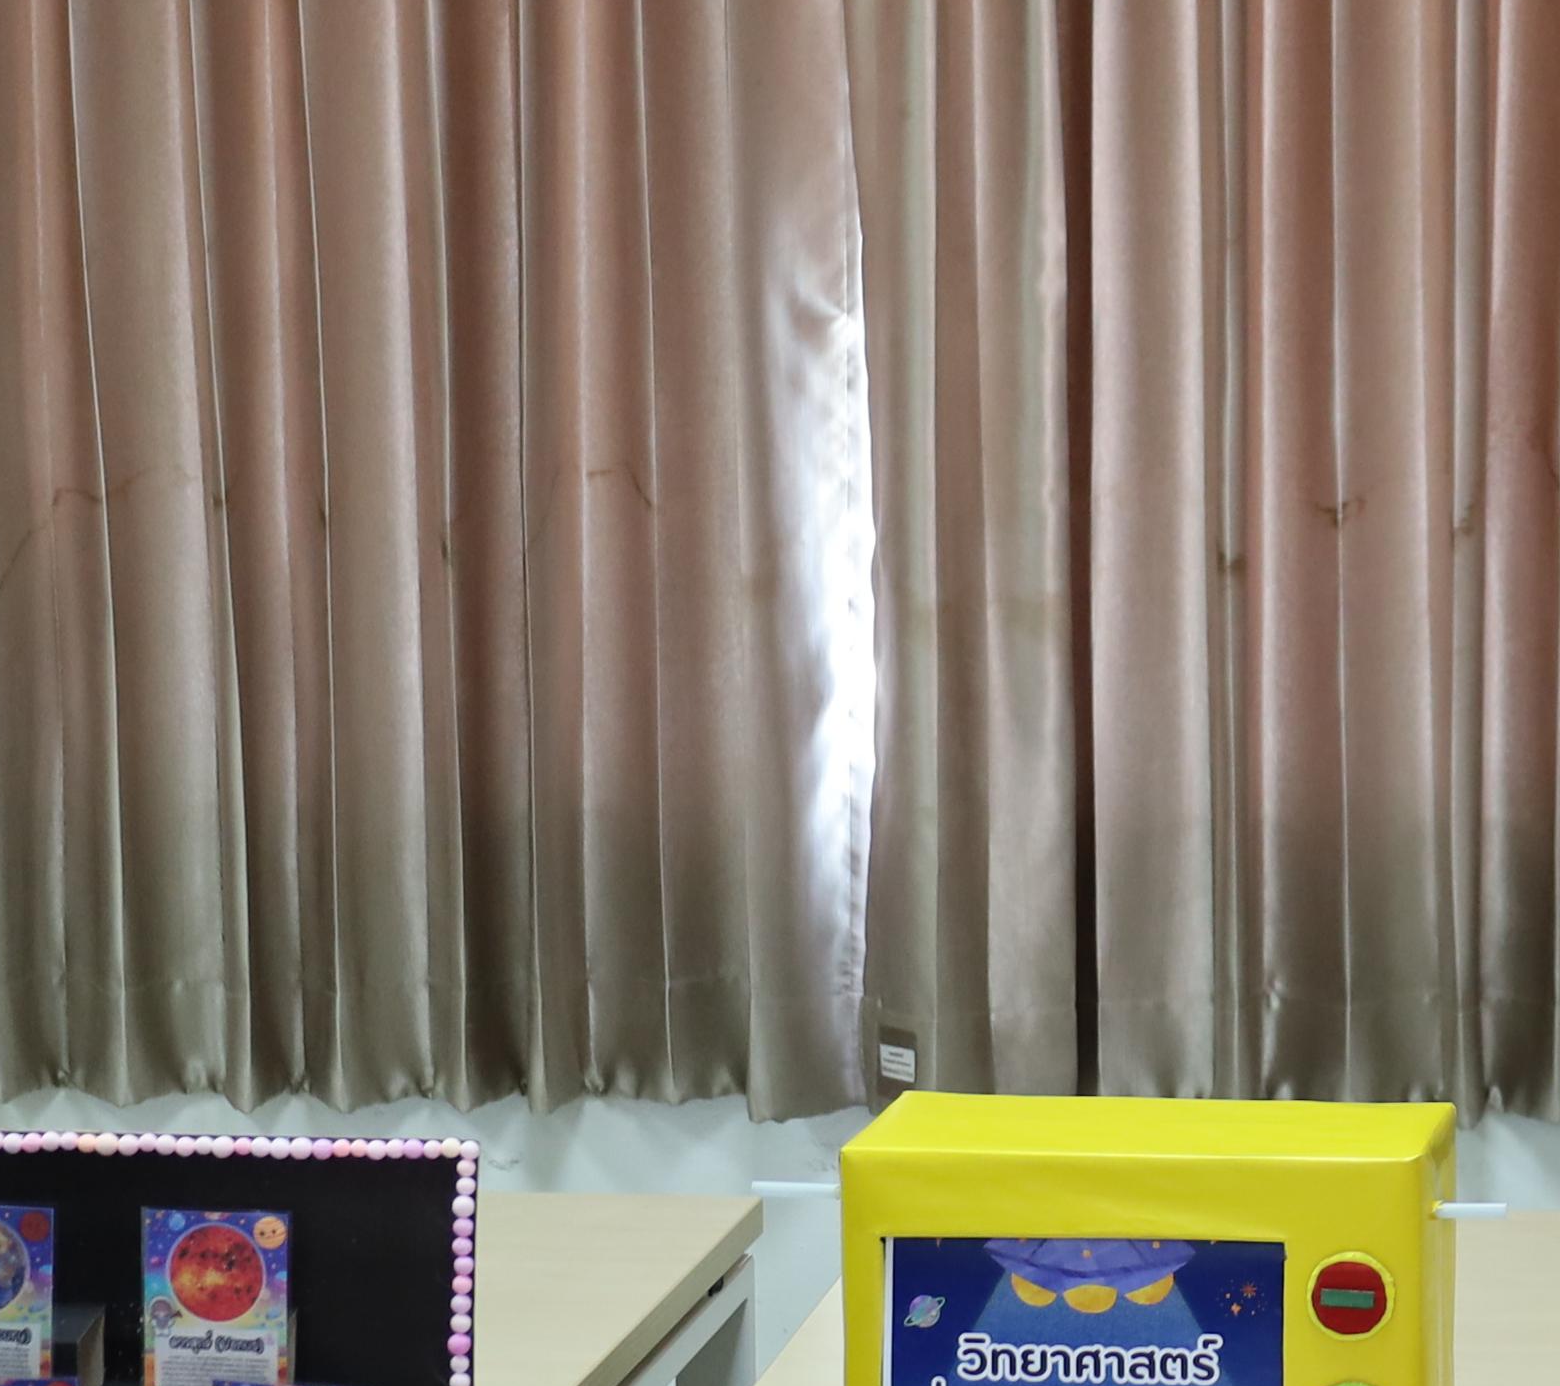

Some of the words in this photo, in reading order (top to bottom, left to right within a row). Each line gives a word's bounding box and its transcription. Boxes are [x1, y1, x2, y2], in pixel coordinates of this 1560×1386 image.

[958, 1334, 1223, 1382] วิทยาศาสตร์
